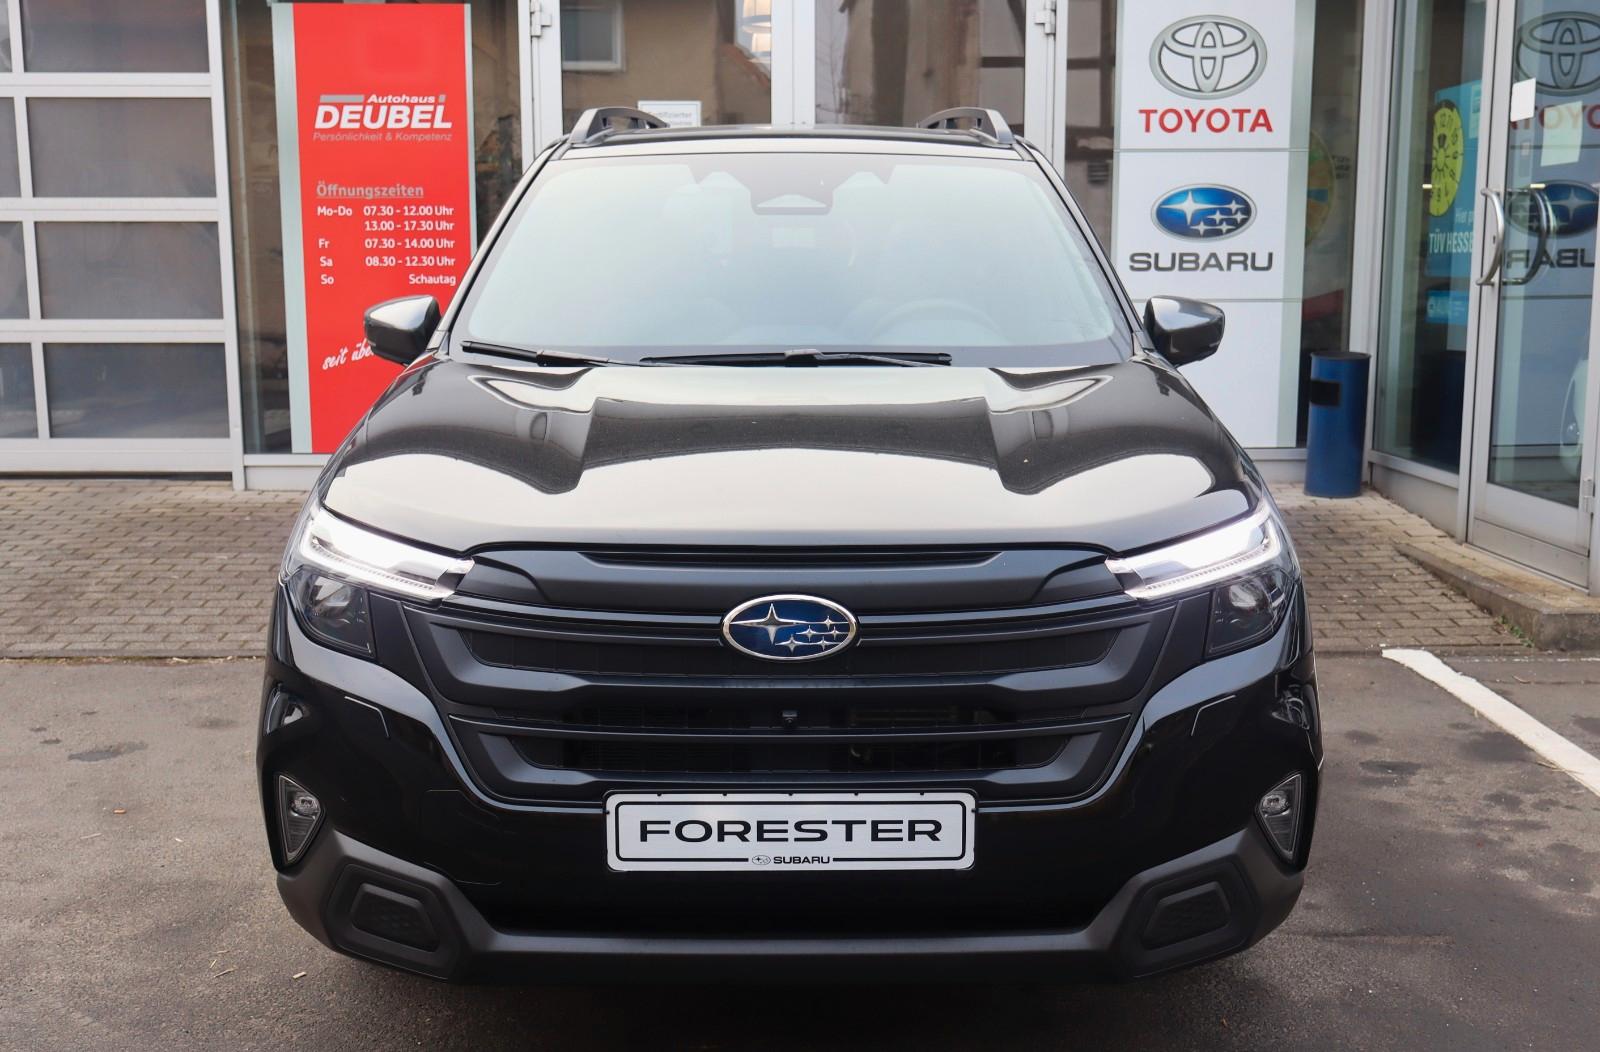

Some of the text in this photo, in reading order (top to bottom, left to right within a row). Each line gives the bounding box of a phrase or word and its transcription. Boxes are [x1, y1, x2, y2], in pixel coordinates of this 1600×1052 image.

[367, 95, 435, 103] Autohaus
[314, 105, 453, 129] DEUBEL
[1138, 108, 1273, 133] TOYOTA
[313, 132, 452, 142] Persönlichkeit & Kompetenz
[316, 181, 424, 199] Öffnungszeiten
[317, 206, 352, 216] Mo-Do
[363, 206, 394, 216] 07.30
[403, 206, 433, 216] 12.00
[435, 206, 454, 216] Uhr
[365, 221, 394, 231] 13.00
[404, 221, 433, 231] 17.30
[435, 221, 455, 231] Uhr
[318, 239, 330, 248] Fr
[365, 239, 395, 248] 07.30
[405, 239, 434, 248] 14.00
[436, 238, 455, 248] Uhr
[1429, 228, 1446, 253] TÜV
[320, 257, 333, 267] Sa
[365, 256, 396, 266] 08.30
[405, 256, 435, 266] 12.30
[436, 256, 456, 266] Uhr
[1129, 252, 1273, 272] SUBARU
[321, 274, 456, 286] So Schautag
[322, 346, 349, 370] seit
[640, 820, 942, 842] FORESTER
[773, 856, 831, 864] SUBARU
